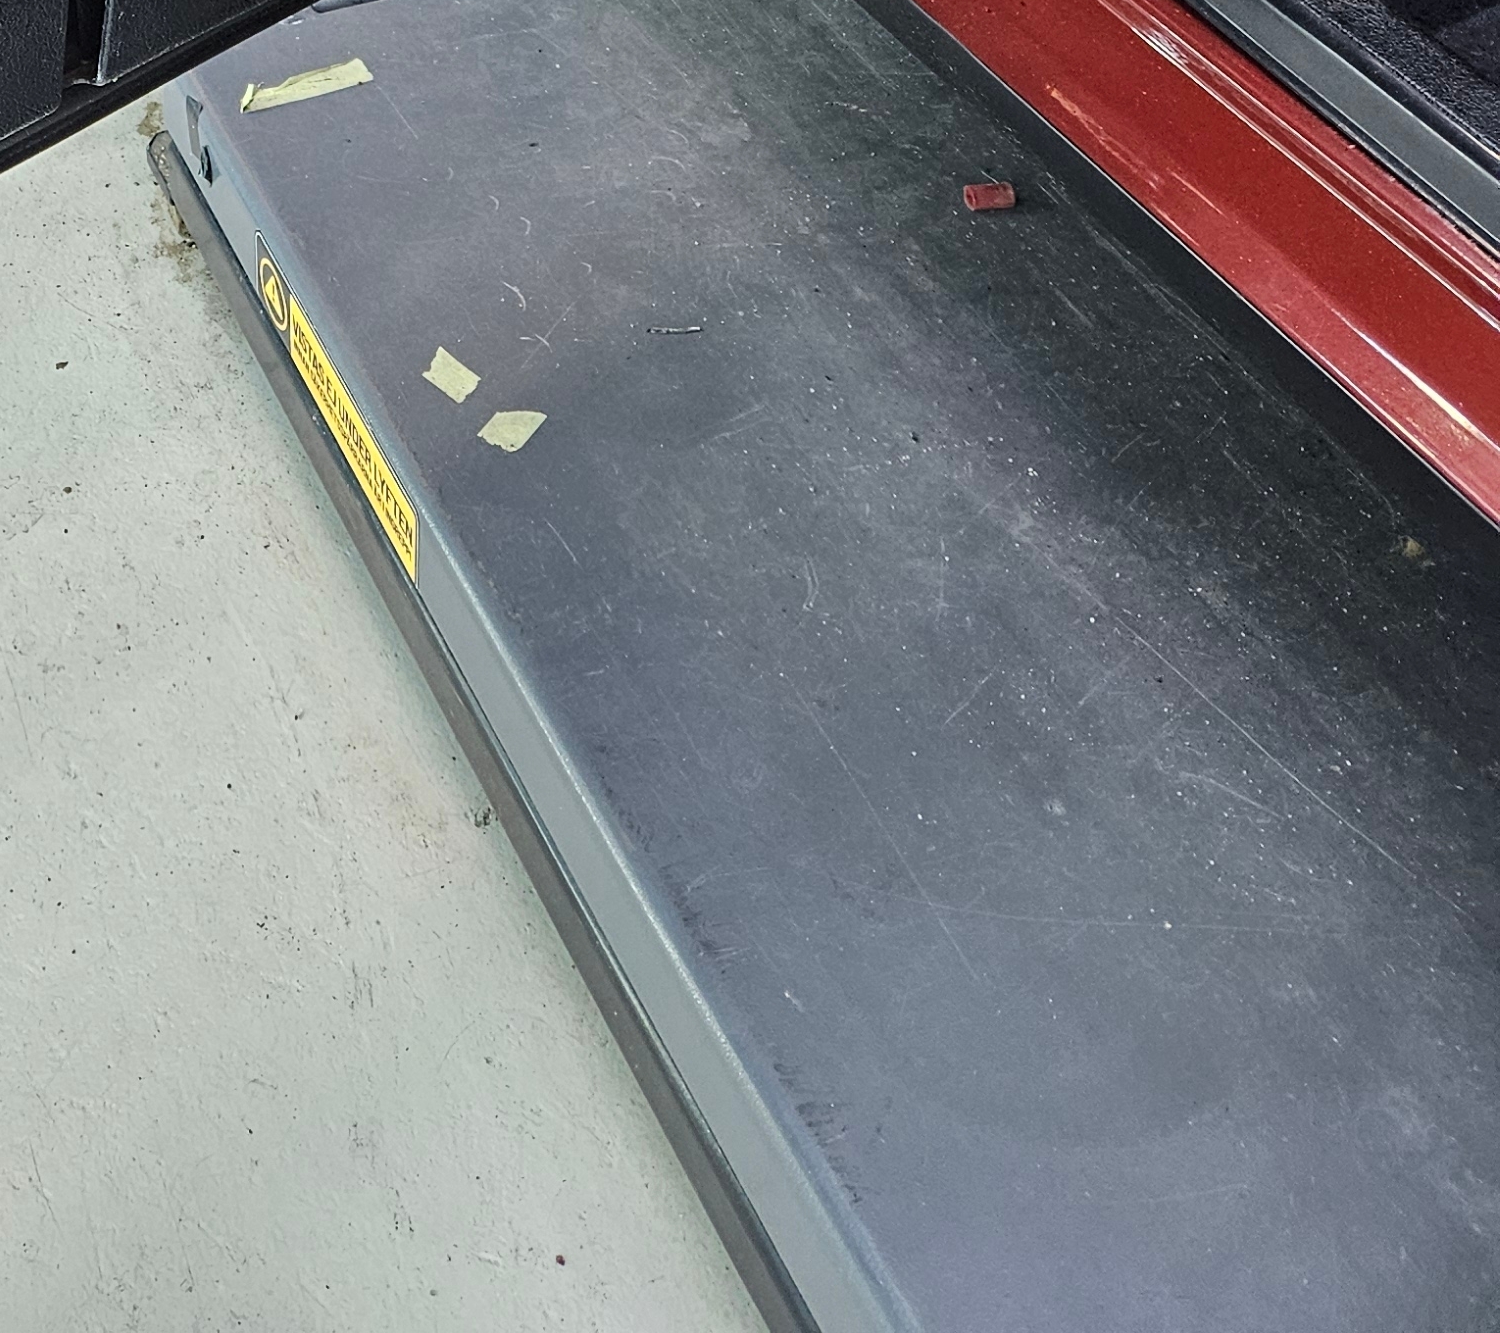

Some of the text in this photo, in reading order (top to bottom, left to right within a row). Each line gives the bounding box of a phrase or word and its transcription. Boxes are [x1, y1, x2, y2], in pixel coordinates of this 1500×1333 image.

[292, 314, 413, 548] VISTAS EJ UNDER LYFTEN
